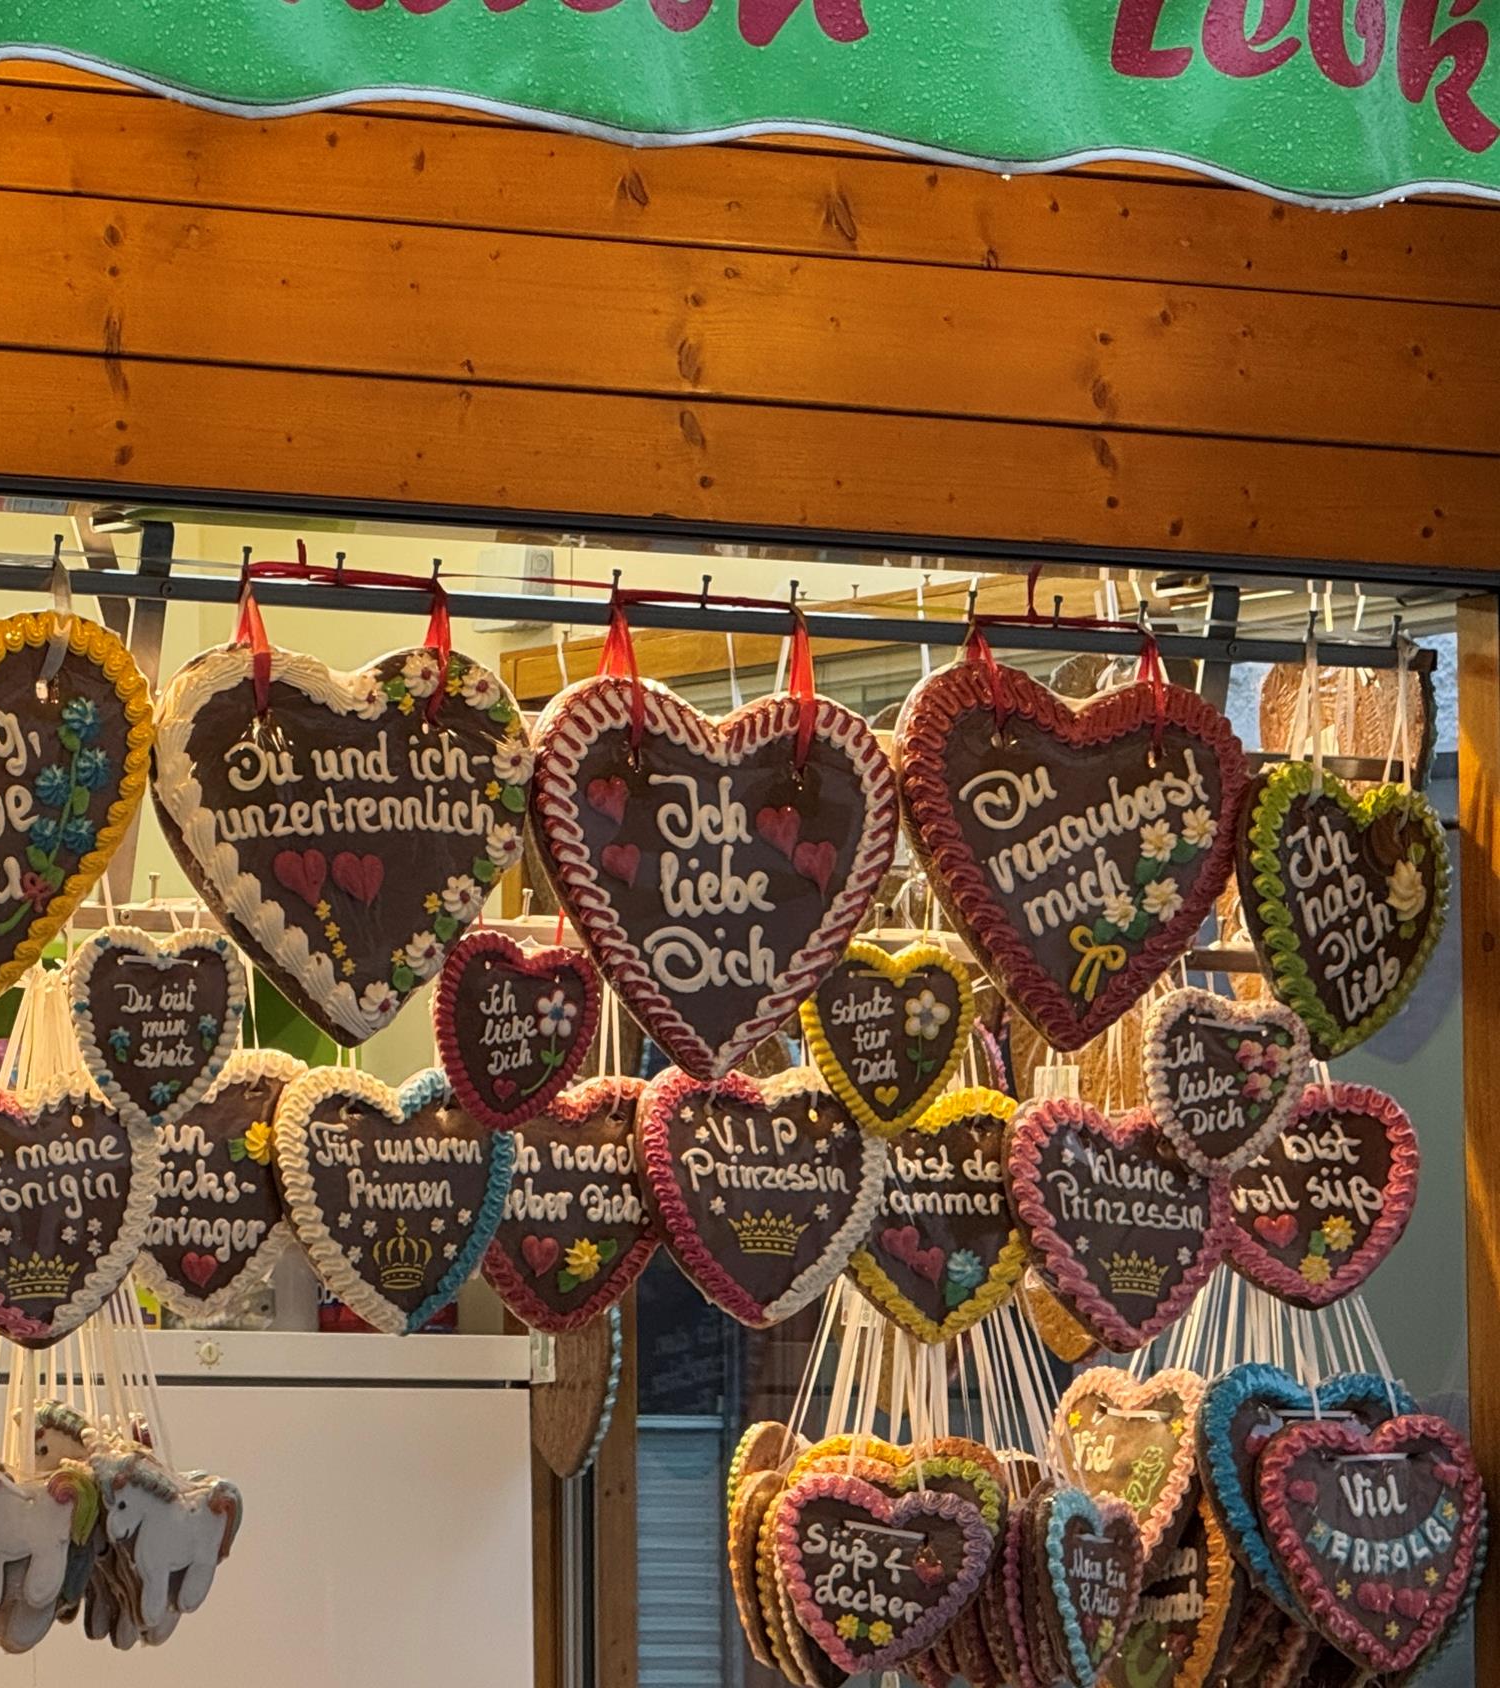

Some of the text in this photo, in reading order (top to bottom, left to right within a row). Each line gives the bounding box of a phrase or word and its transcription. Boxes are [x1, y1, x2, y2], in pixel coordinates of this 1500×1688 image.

[223, 730, 492, 792] Du und ich-
[215, 785, 494, 842] unzertrennlich
[648, 773, 753, 850] Ich
[958, 765, 1058, 831] Du
[1285, 815, 1358, 888] Ich
[659, 844, 776, 918] liebe
[1023, 846, 1131, 937] mich
[1296, 865, 1366, 938] hab
[643, 924, 776, 994] Dich
[1316, 896, 1396, 981] Dich
[114, 978, 198, 1014] Du bist
[479, 980, 517, 1015] Ich
[831, 986, 894, 1025] Schatz
[142, 1012, 189, 1039] mein
[479, 1015, 538, 1045] liebe
[852, 1023, 891, 1053] für
[133, 1038, 195, 1068] Schatz
[487, 1039, 533, 1075] Dich
[852, 1050, 898, 1085] Dich
[1164, 1031, 1205, 1069] Ich
[1176, 1065, 1241, 1107] liebe
[707, 1115, 797, 1155] V.I.P
[1180, 1102, 1246, 1136] Dich
[15, 1132, 125, 1171] meine
[309, 1121, 364, 1167] Für
[895, 1145, 955, 1183] bist
[1280, 1123, 1362, 1165] bist
[347, 1168, 454, 1211] Prinzen
[681, 1147, 850, 1194] Prinzessin
[880, 1190, 1004, 1216] ammer
[1047, 1169, 1205, 1232] Prinzessin
[1230, 1167, 1384, 1225] voll süß
[1339, 1472, 1408, 1519] Viel
[1328, 1518, 1452, 1574] ERFOLG
